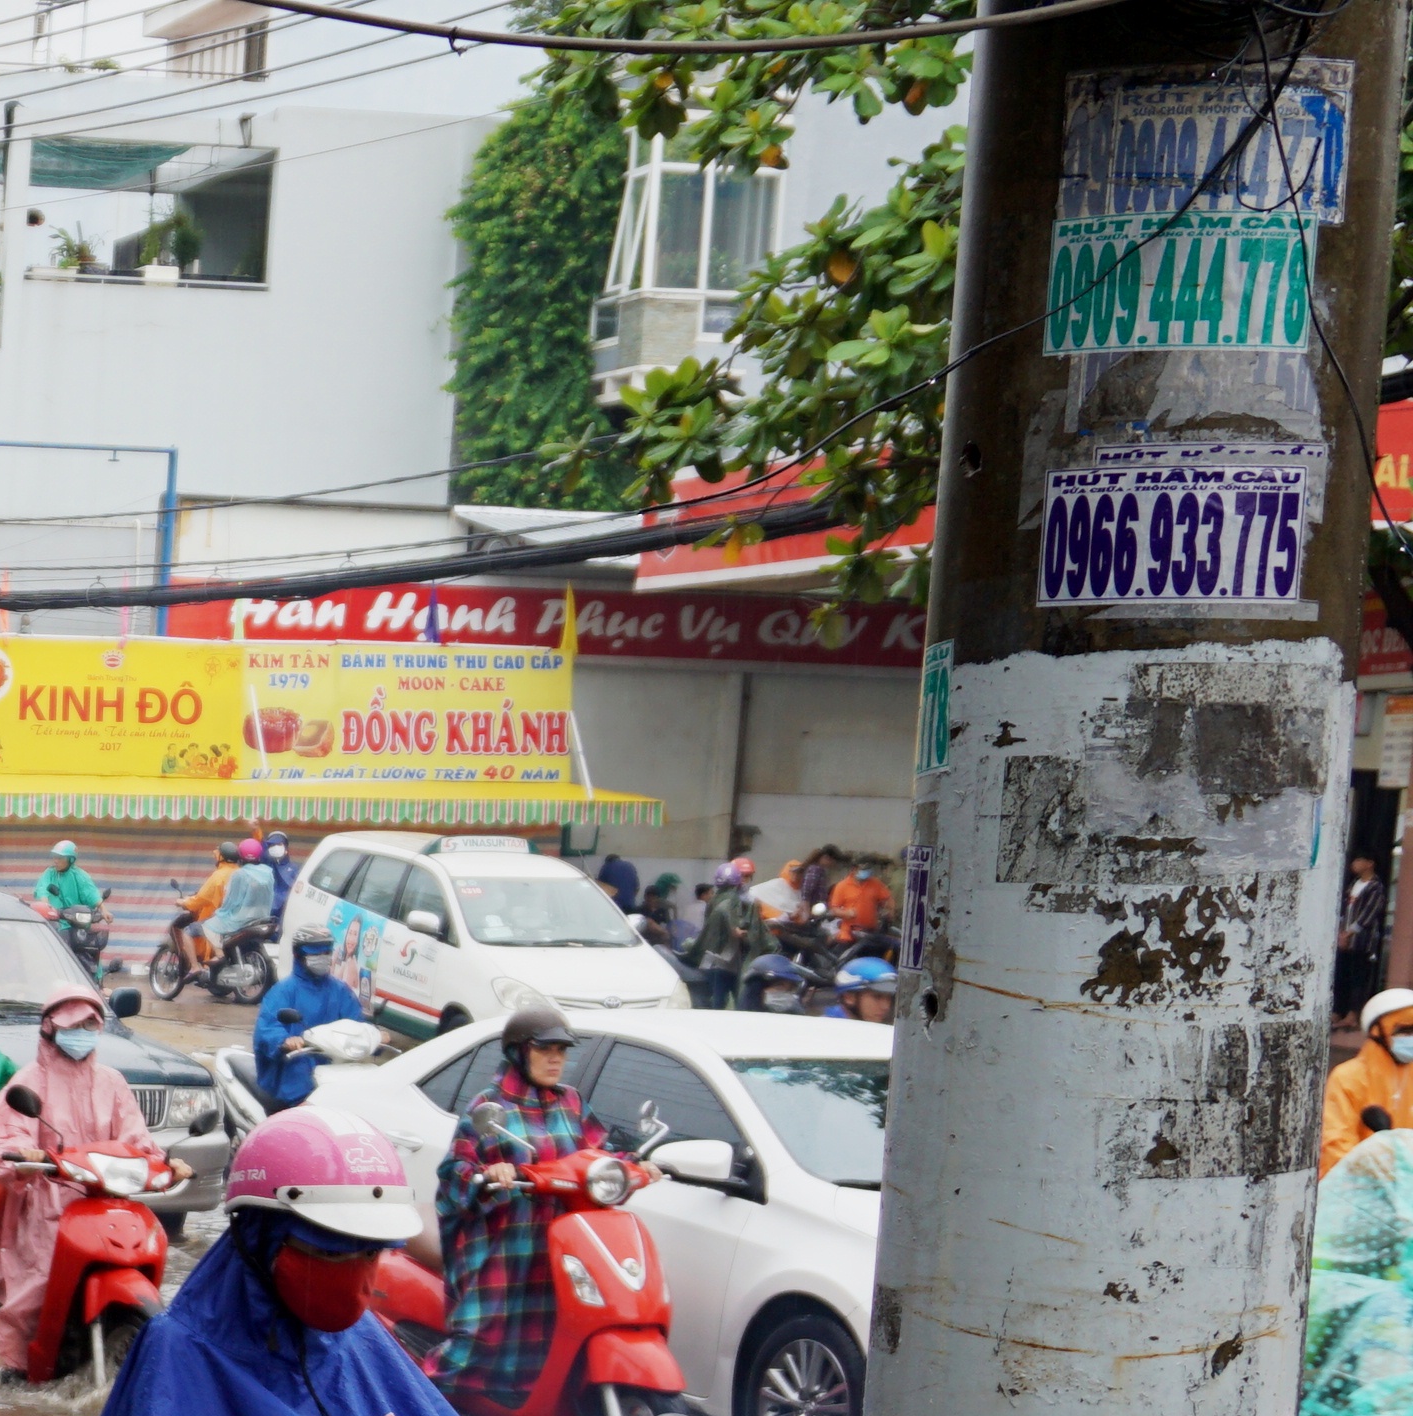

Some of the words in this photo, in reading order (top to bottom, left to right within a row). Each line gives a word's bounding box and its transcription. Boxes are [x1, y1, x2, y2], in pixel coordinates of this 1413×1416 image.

[1059, 219, 1133, 237] HÚT
[1050, 238, 1308, 349] 0909.444.778
[1052, 470, 1127, 488] HÚT
[1045, 492, 1300, 599] 0966.933.775
[678, 604, 742, 655] Vụ
[248, 652, 284, 669] KIM
[291, 649, 330, 669] TÂN
[341, 650, 386, 669] BÁNH
[393, 654, 448, 669] TRUNG
[454, 654, 487, 669] THU
[492, 654, 524, 670] CAO
[530, 648, 564, 670] CẤP
[268, 673, 310, 689] 1979
[398, 676, 446, 691] MOON
[459, 676, 506, 691] CAKE
[18, 684, 124, 723] KINH
[135, 680, 203, 725] ĐÔ
[341, 685, 437, 755] ĐỒNG
[445, 698, 570, 755] KHÁNH
[99, 743, 122, 751] 2017
[483, 765, 515, 780] 40
